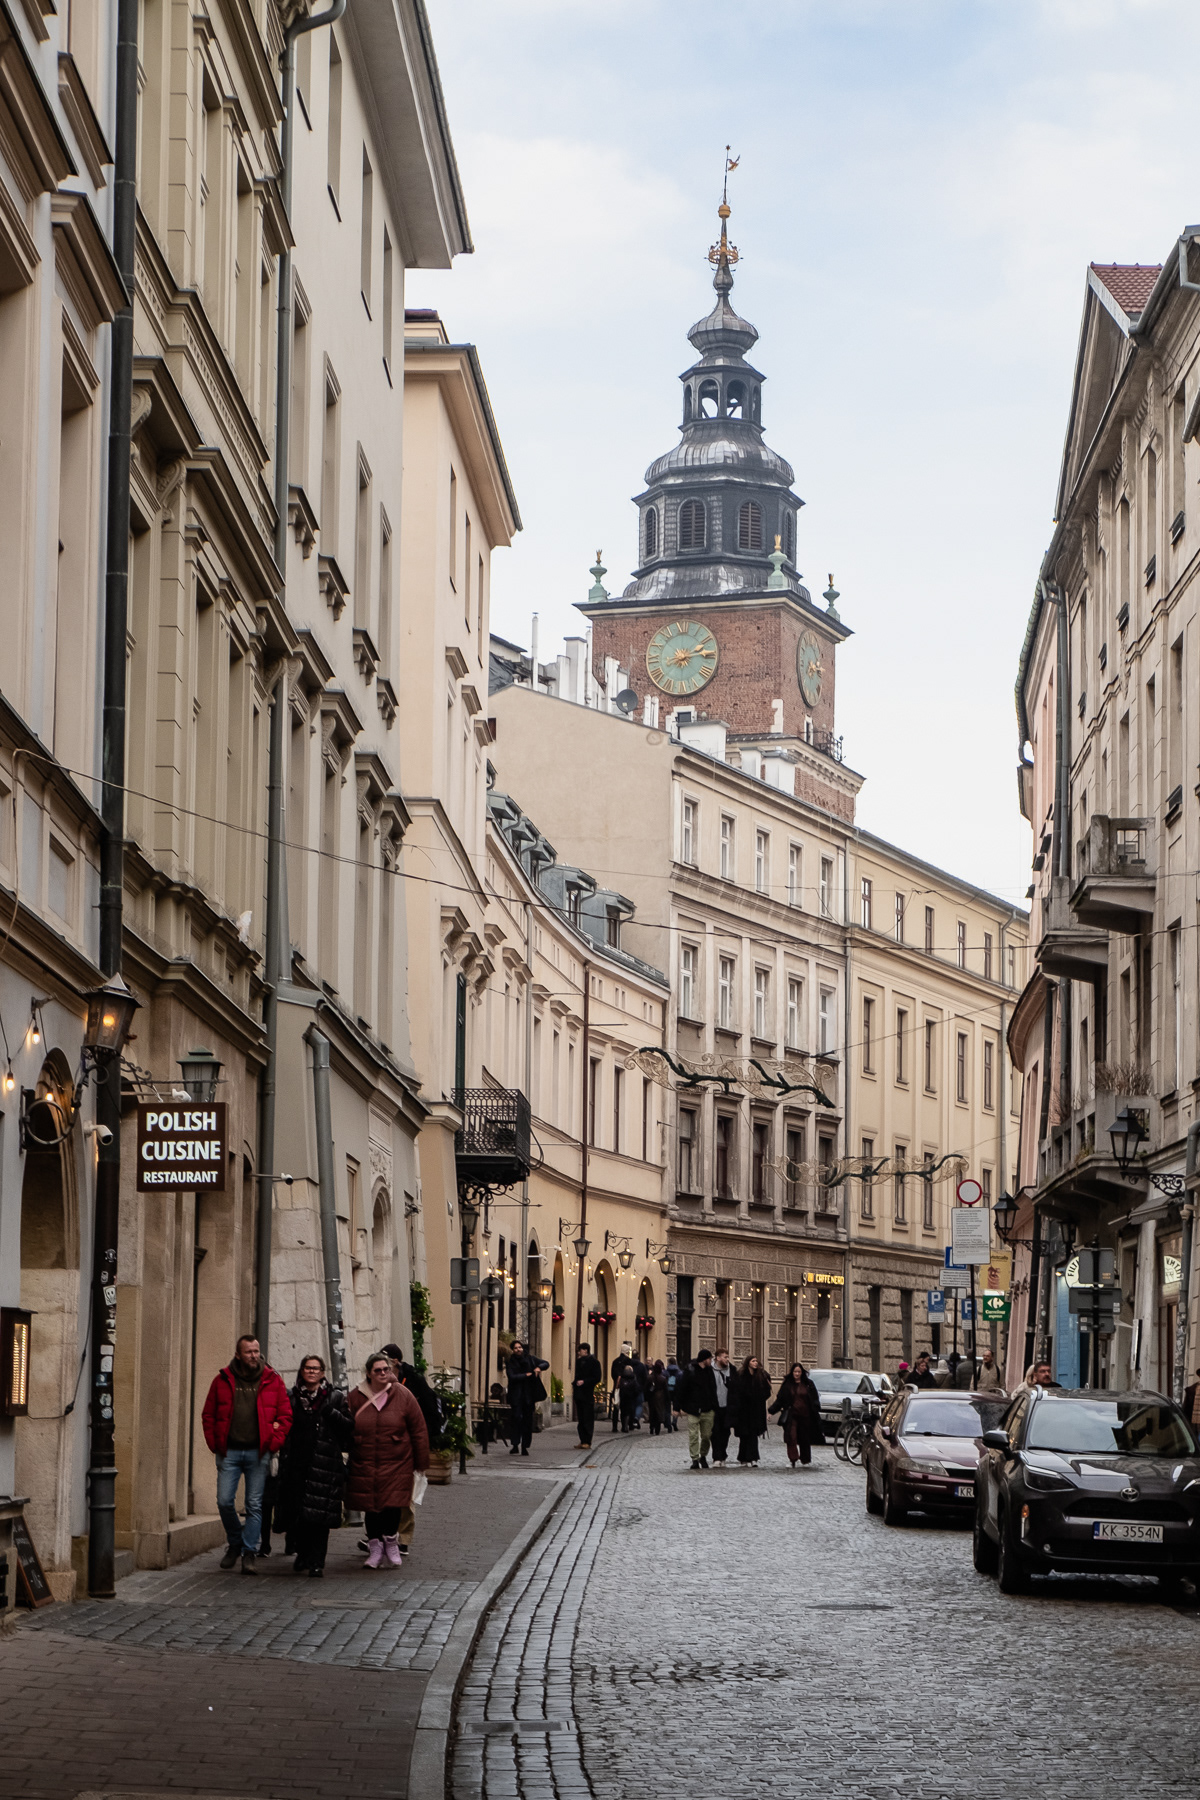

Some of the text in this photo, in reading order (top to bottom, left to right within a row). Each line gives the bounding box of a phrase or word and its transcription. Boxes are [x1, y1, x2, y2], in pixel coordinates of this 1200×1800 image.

[146, 1111, 217, 1132] POLISH
[141, 1140, 221, 1161] CUISINE
[143, 1170, 218, 1184] RESTAURANT
[931, 1291, 941, 1306] P
[960, 1487, 973, 1497] KR
[1102, 1524, 1160, 1539] KK 3554N
